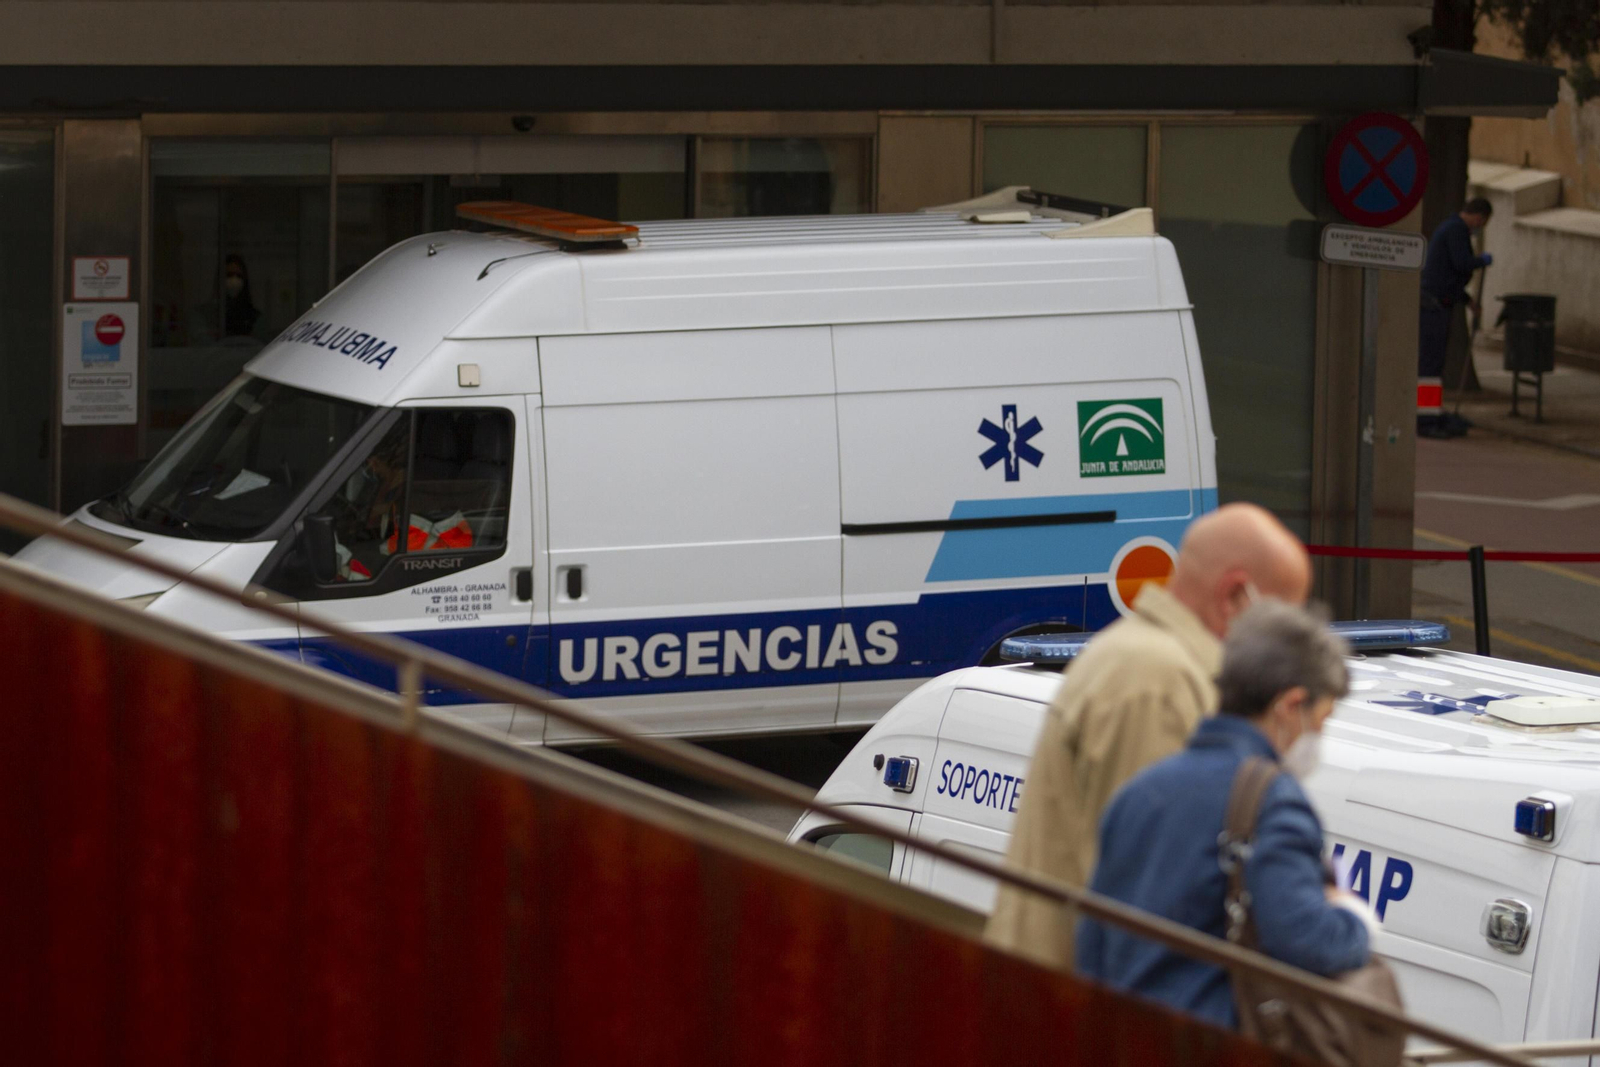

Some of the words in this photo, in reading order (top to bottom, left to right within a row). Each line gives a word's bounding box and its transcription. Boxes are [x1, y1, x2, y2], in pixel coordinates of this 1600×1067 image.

[1081, 461, 1106, 473] JUNTA
[1108, 460, 1120, 472] DE
[401, 557, 464, 570] TRANSIT
[411, 585, 458, 596] ALHAMBRA
[465, 583, 507, 593] GRANADA
[460, 595, 469, 604] 40
[460, 604, 469, 612] 42
[437, 613, 480, 623] GRANADA
[559, 620, 899, 685] URGENCIAS
[937, 760, 1025, 814] SOPORTE
[1332, 843, 1413, 923] AP
